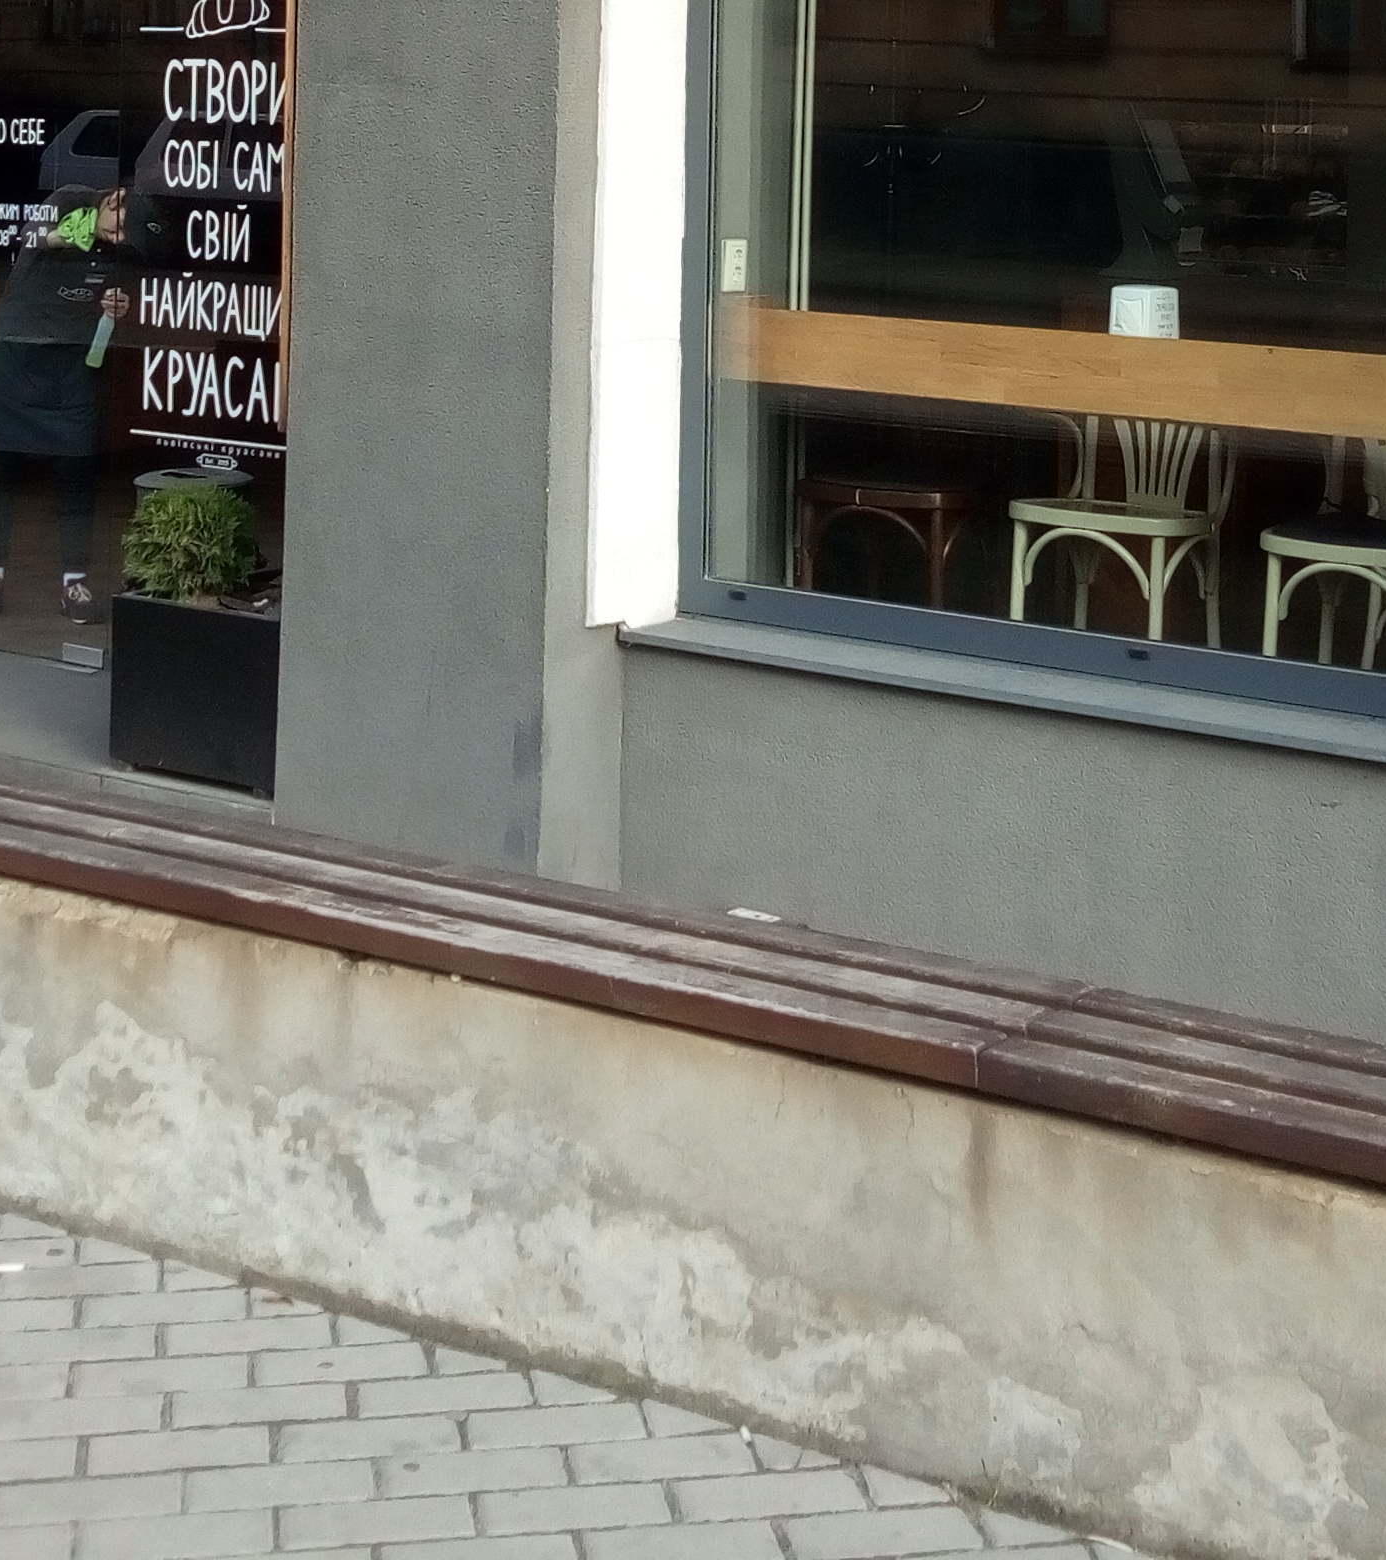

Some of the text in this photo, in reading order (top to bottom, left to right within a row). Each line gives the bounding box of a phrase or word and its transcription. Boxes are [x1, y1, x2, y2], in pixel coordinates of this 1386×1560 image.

[10, 118, 46, 145] СЕБЕ
[164, 139, 285, 192] СОБІ САМ
[23, 204, 59, 222] РОБОТИ
[186, 204, 251, 263] СВІЙ
